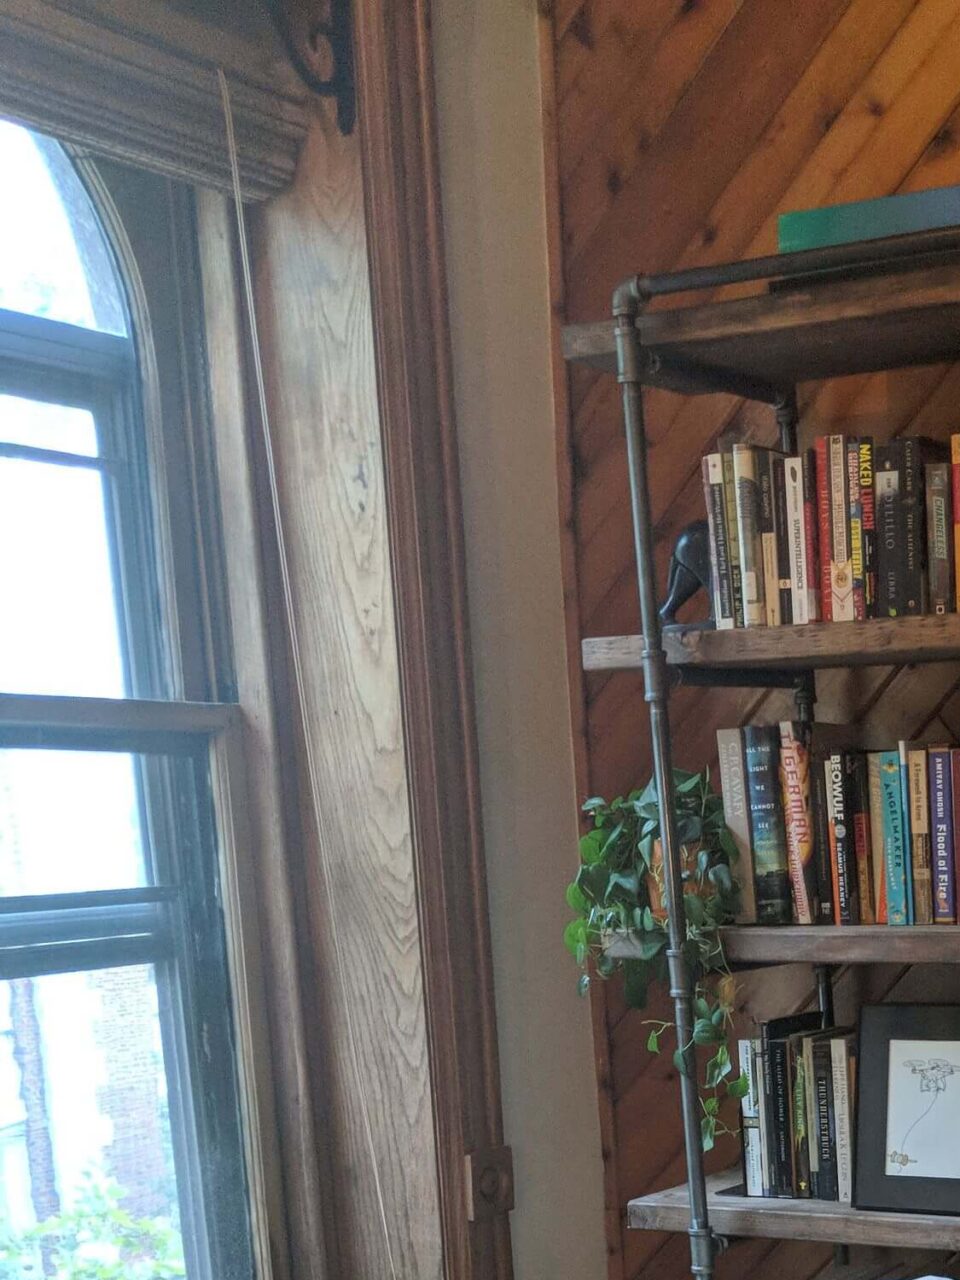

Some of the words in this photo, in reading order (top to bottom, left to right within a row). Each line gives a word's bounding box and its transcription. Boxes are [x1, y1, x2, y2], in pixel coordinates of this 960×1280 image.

[859, 443, 873, 486] NAKED
[862, 488, 874, 530] LUNCH
[934, 498, 946, 558] CHANGELESS
[793, 519, 803, 590] SUPERINTELLIGENCE
[887, 571, 896, 600] LIBRA
[780, 733, 809, 845] TIGERMAN
[831, 755, 845, 821] BEOWULF
[936, 791, 944, 818] GHOSH
[883, 783, 902, 869] ANGELMAKER
[937, 824, 949, 857] Flood
[938, 859, 949, 871] of
[939, 873, 949, 898] Fire
[818, 1080, 831, 1160] THUNDERSTRUCK
